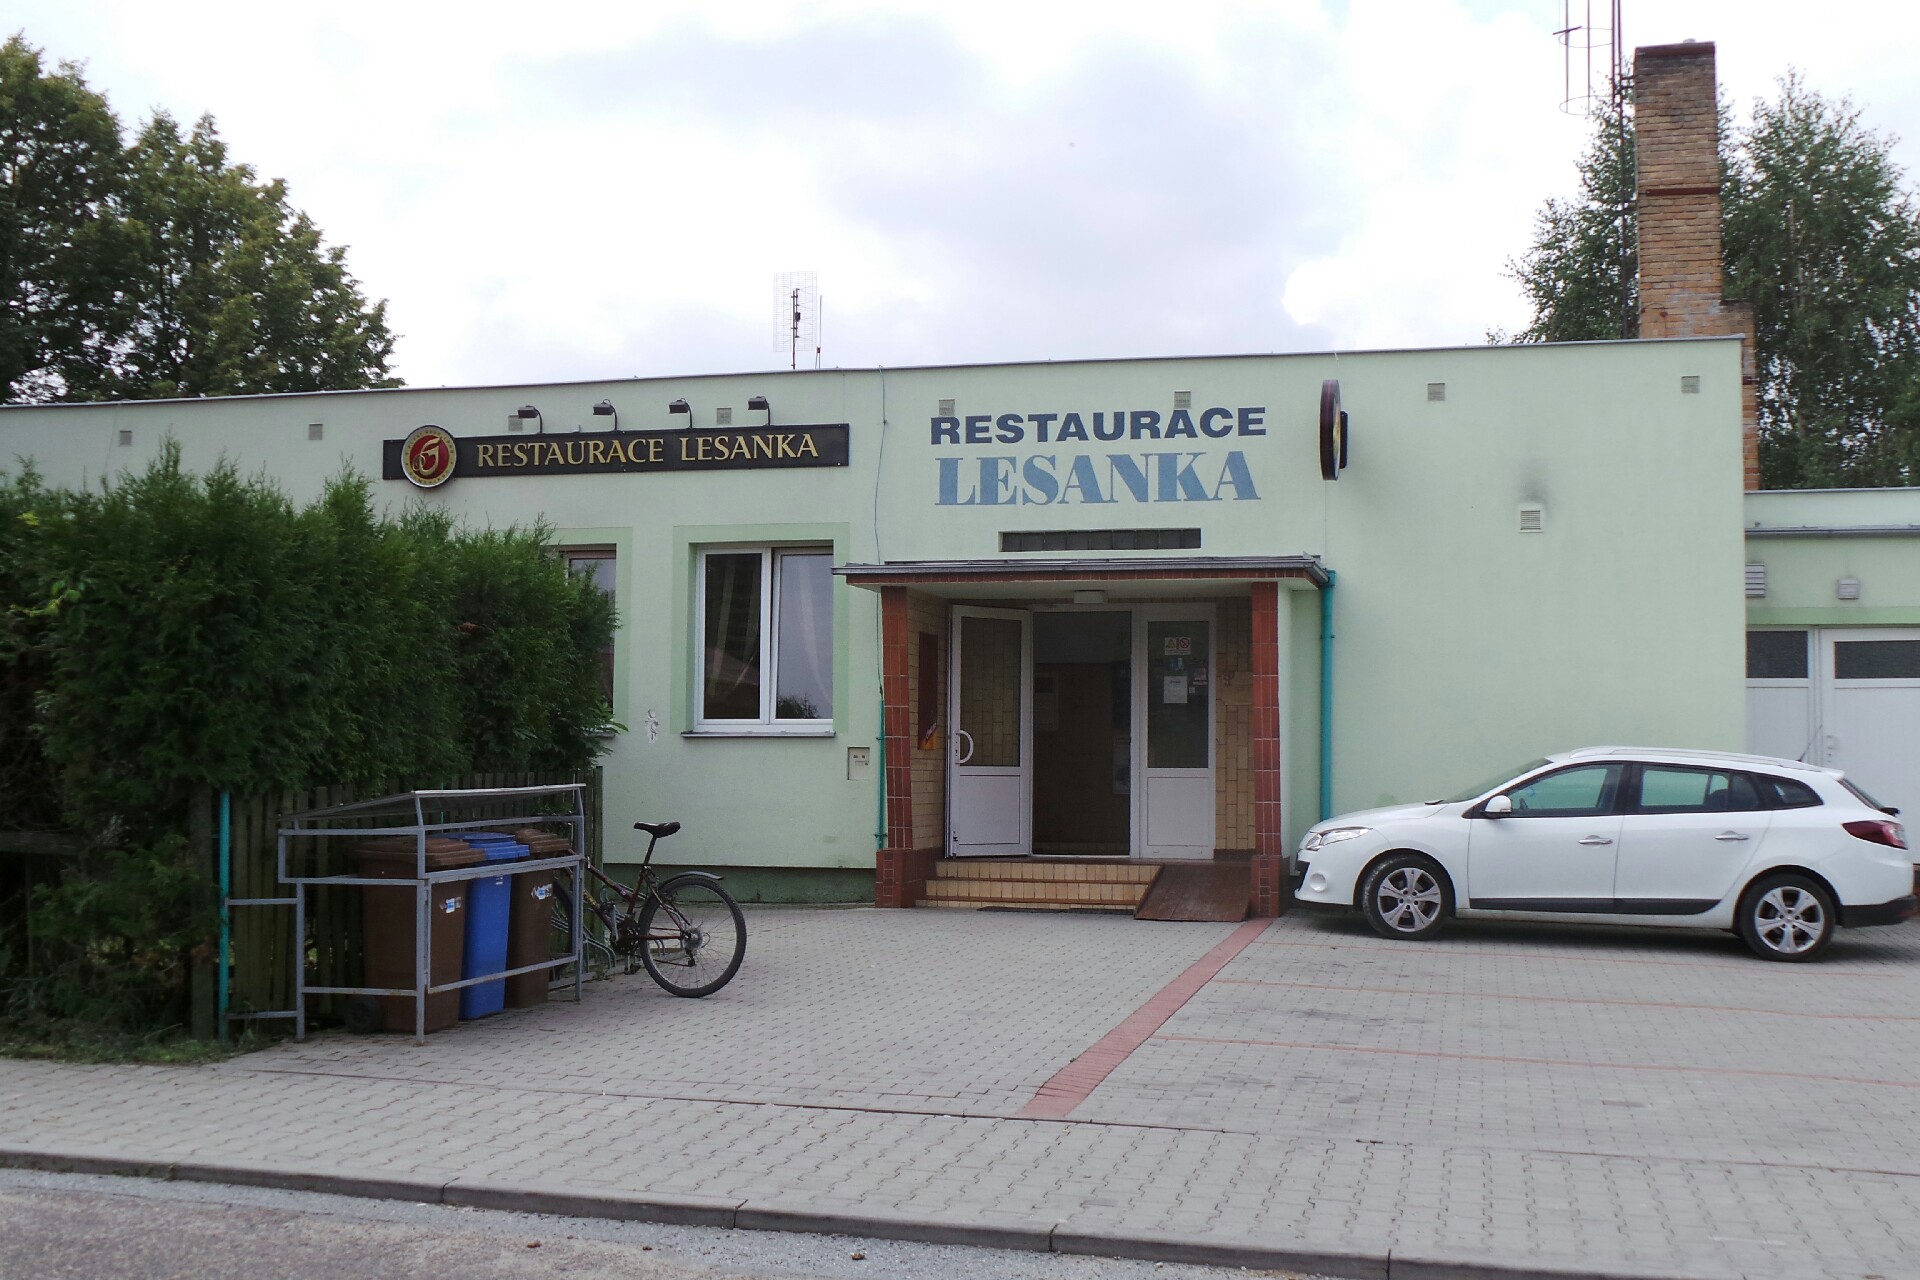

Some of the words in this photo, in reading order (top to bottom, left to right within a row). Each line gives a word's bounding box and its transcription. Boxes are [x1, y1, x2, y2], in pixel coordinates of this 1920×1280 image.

[930, 407, 1266, 445] RESTAURACE
[477, 438, 664, 468] RESTAURACE
[680, 433, 819, 461] LESANKA
[934, 451, 1261, 506] LESANKA
